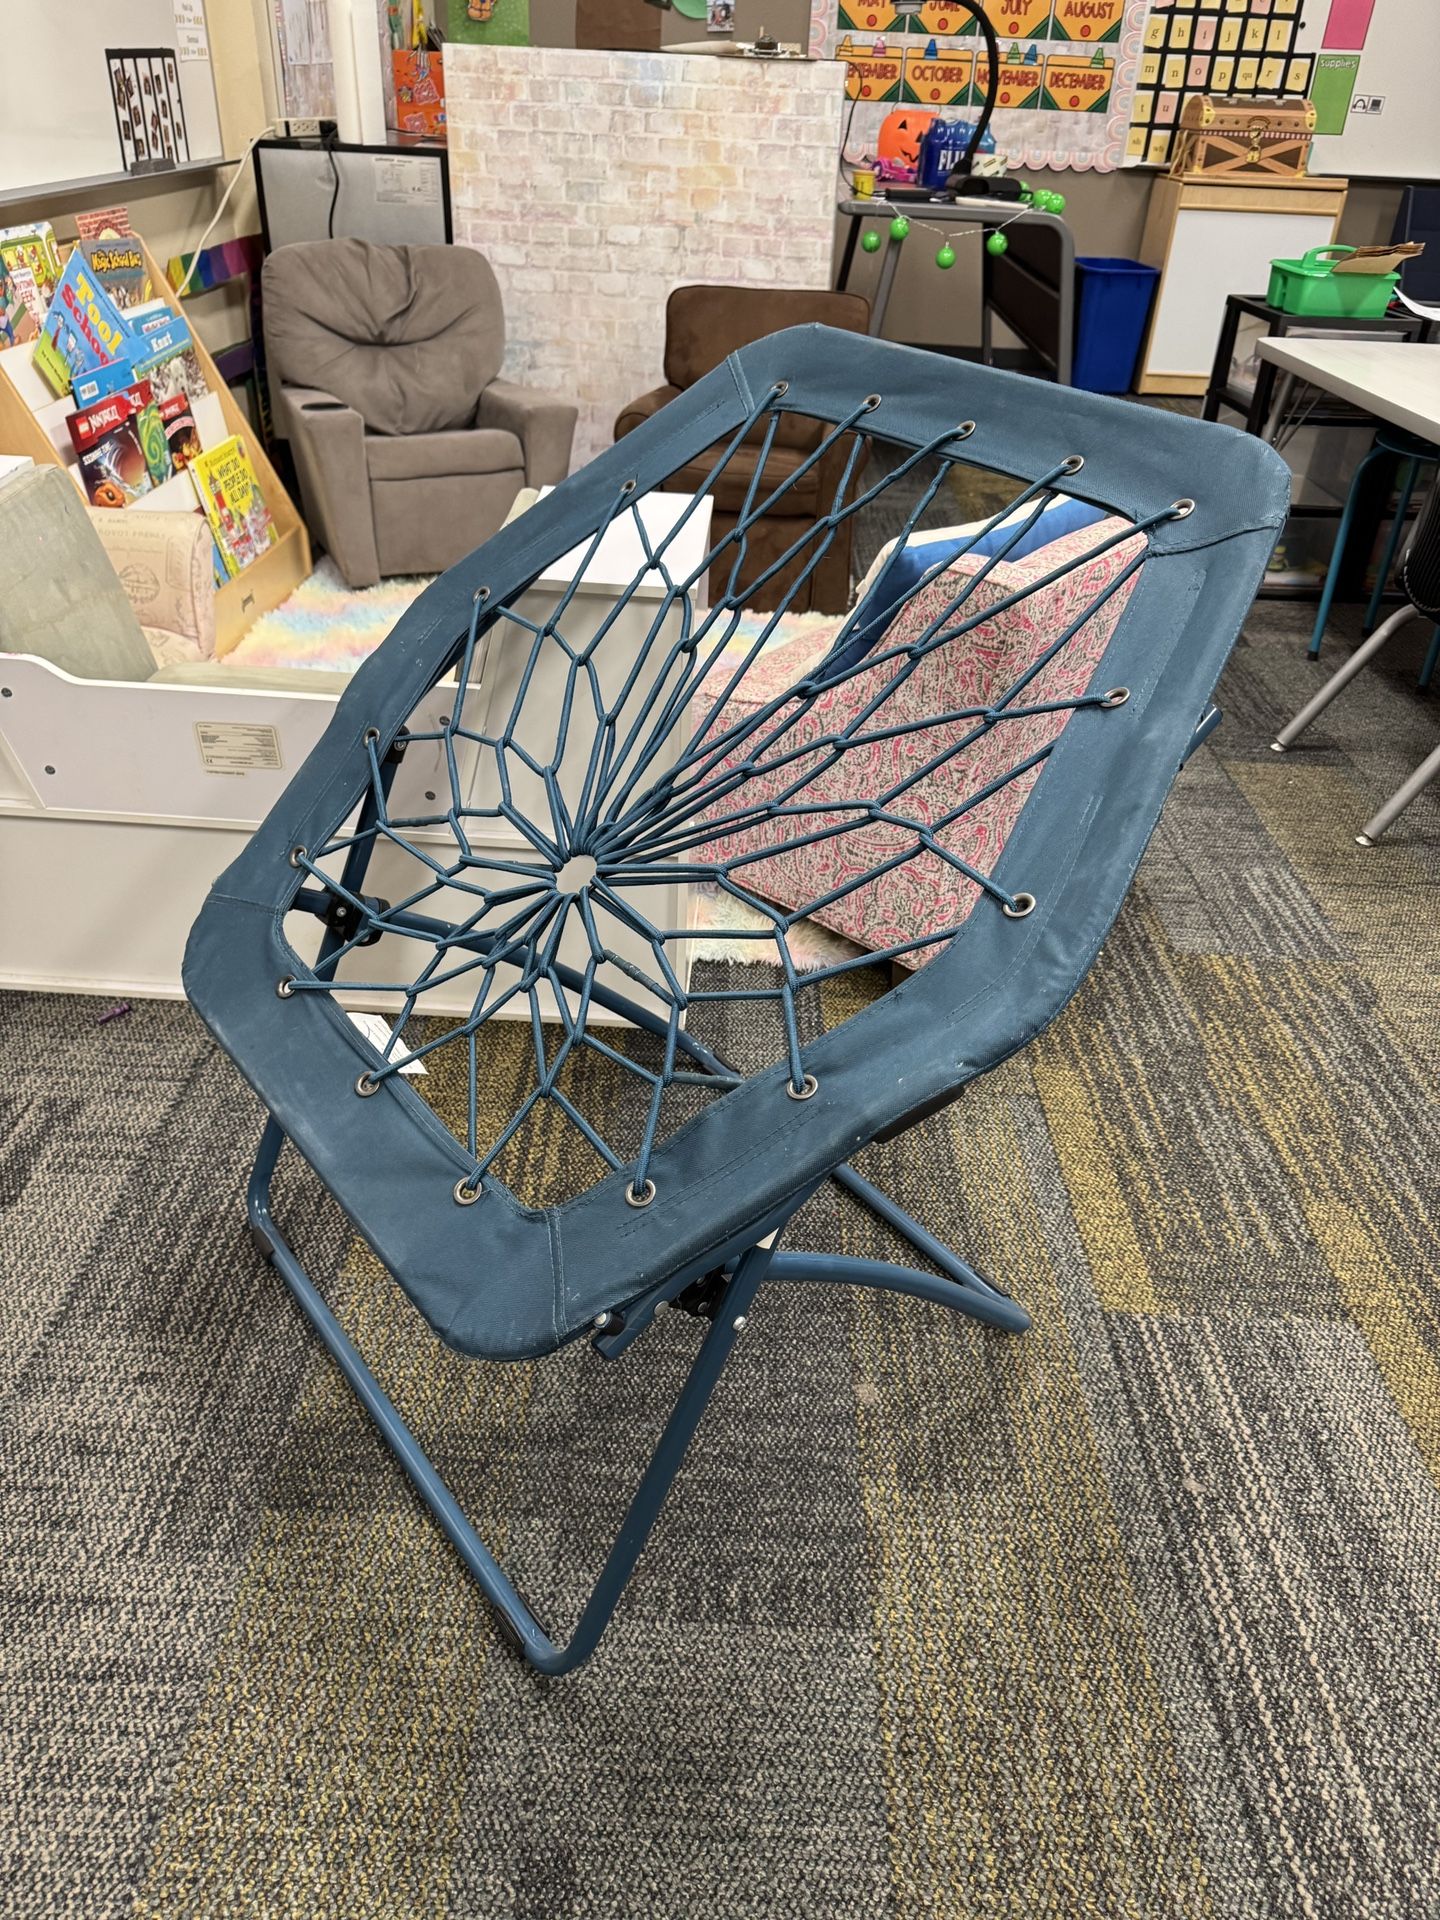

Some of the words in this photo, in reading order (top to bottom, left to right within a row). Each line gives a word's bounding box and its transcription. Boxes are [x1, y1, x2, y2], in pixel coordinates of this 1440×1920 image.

[1000, 0, 1032, 15] JULY
[1064, 1, 1115, 19] AUGUST
[1150, 27, 1160, 39] g
[1177, 27, 1185, 37] h
[1251, 28, 1259, 39] k
[1320, 58, 1357, 69] supplies
[912, 65, 963, 83] OCTOBER
[1049, 71, 1106, 91] DECEMBER
[1144, 65, 1155, 73] m
[1195, 68, 1202, 76] o
[1218, 72, 1226, 82] p
[1293, 72, 1301, 80] s
[76, 272, 123, 356] Tool
